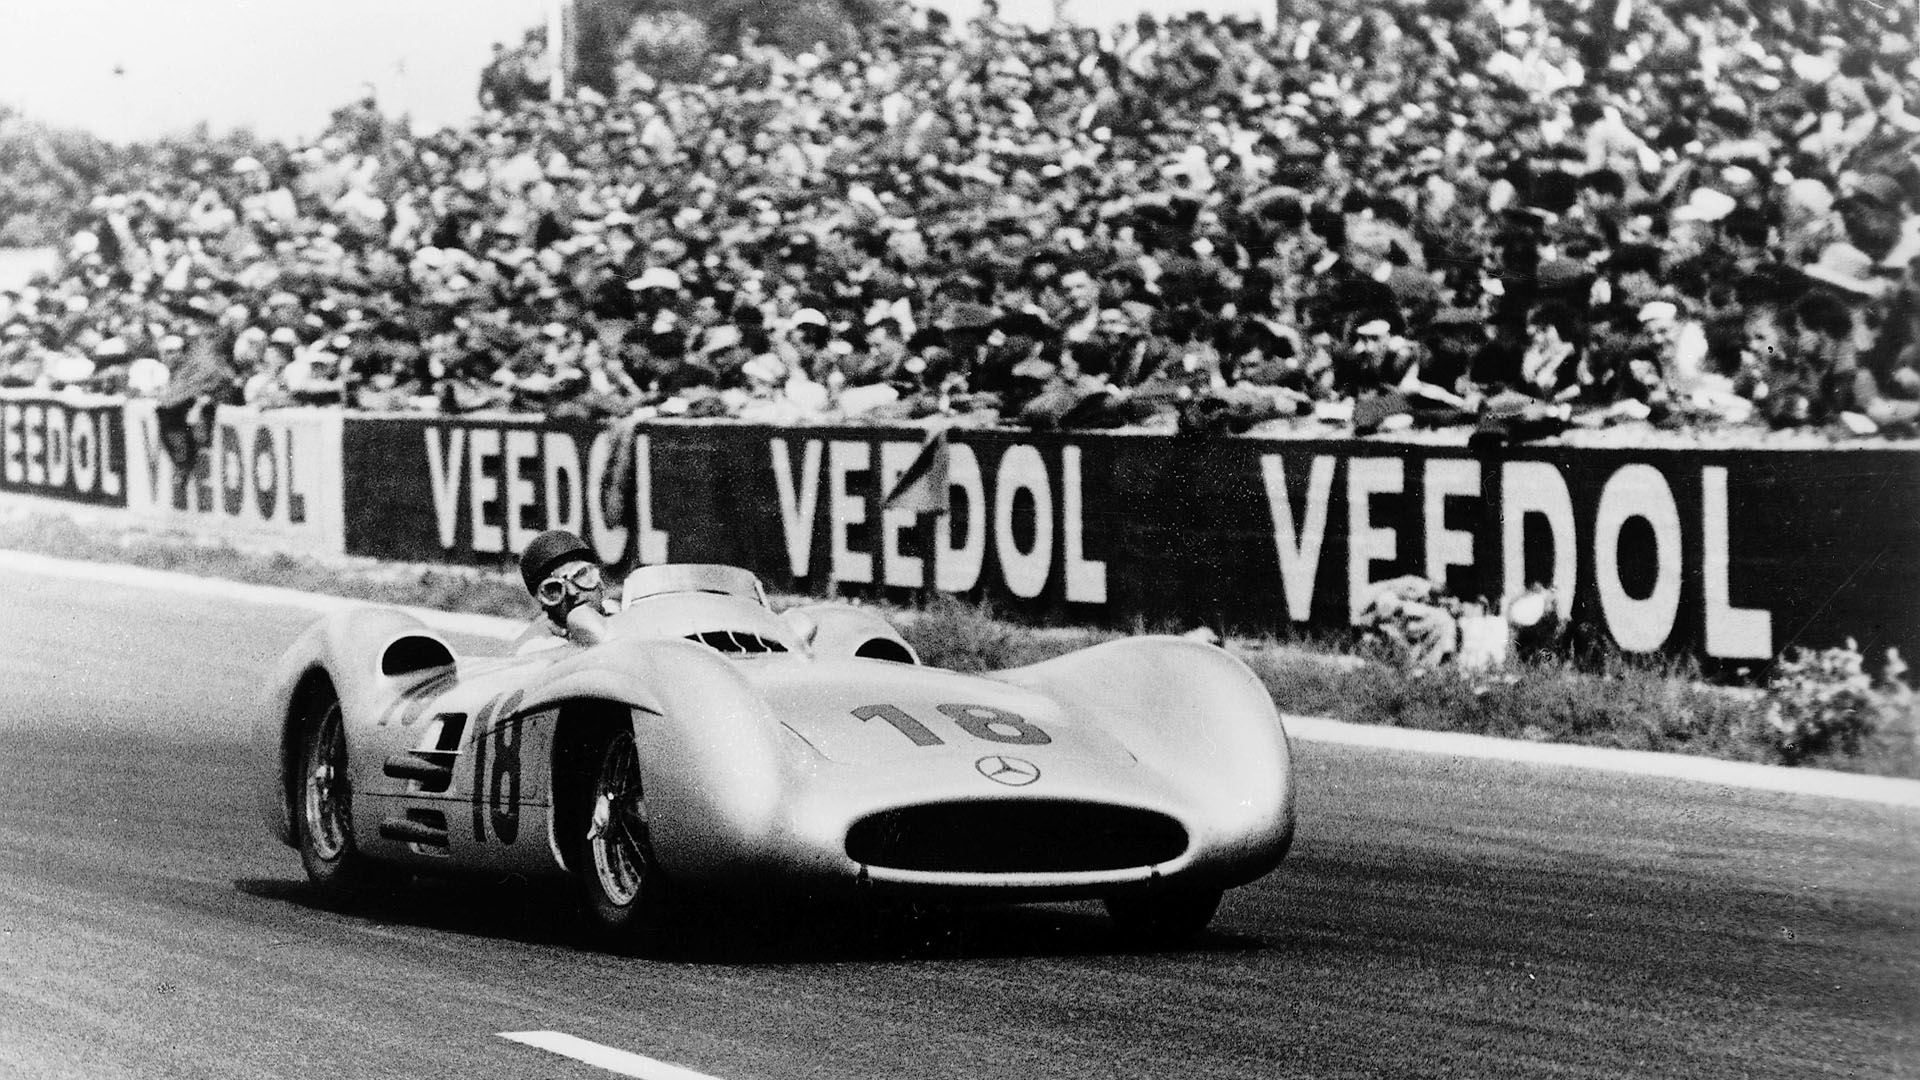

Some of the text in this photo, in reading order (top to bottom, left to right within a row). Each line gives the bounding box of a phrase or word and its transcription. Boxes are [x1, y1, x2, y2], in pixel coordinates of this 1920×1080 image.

[770, 437, 1107, 604] VEEDOL
[1261, 454, 1773, 660] VEEDOL
[471, 689, 525, 845] 18
[850, 703, 1052, 746] 18
